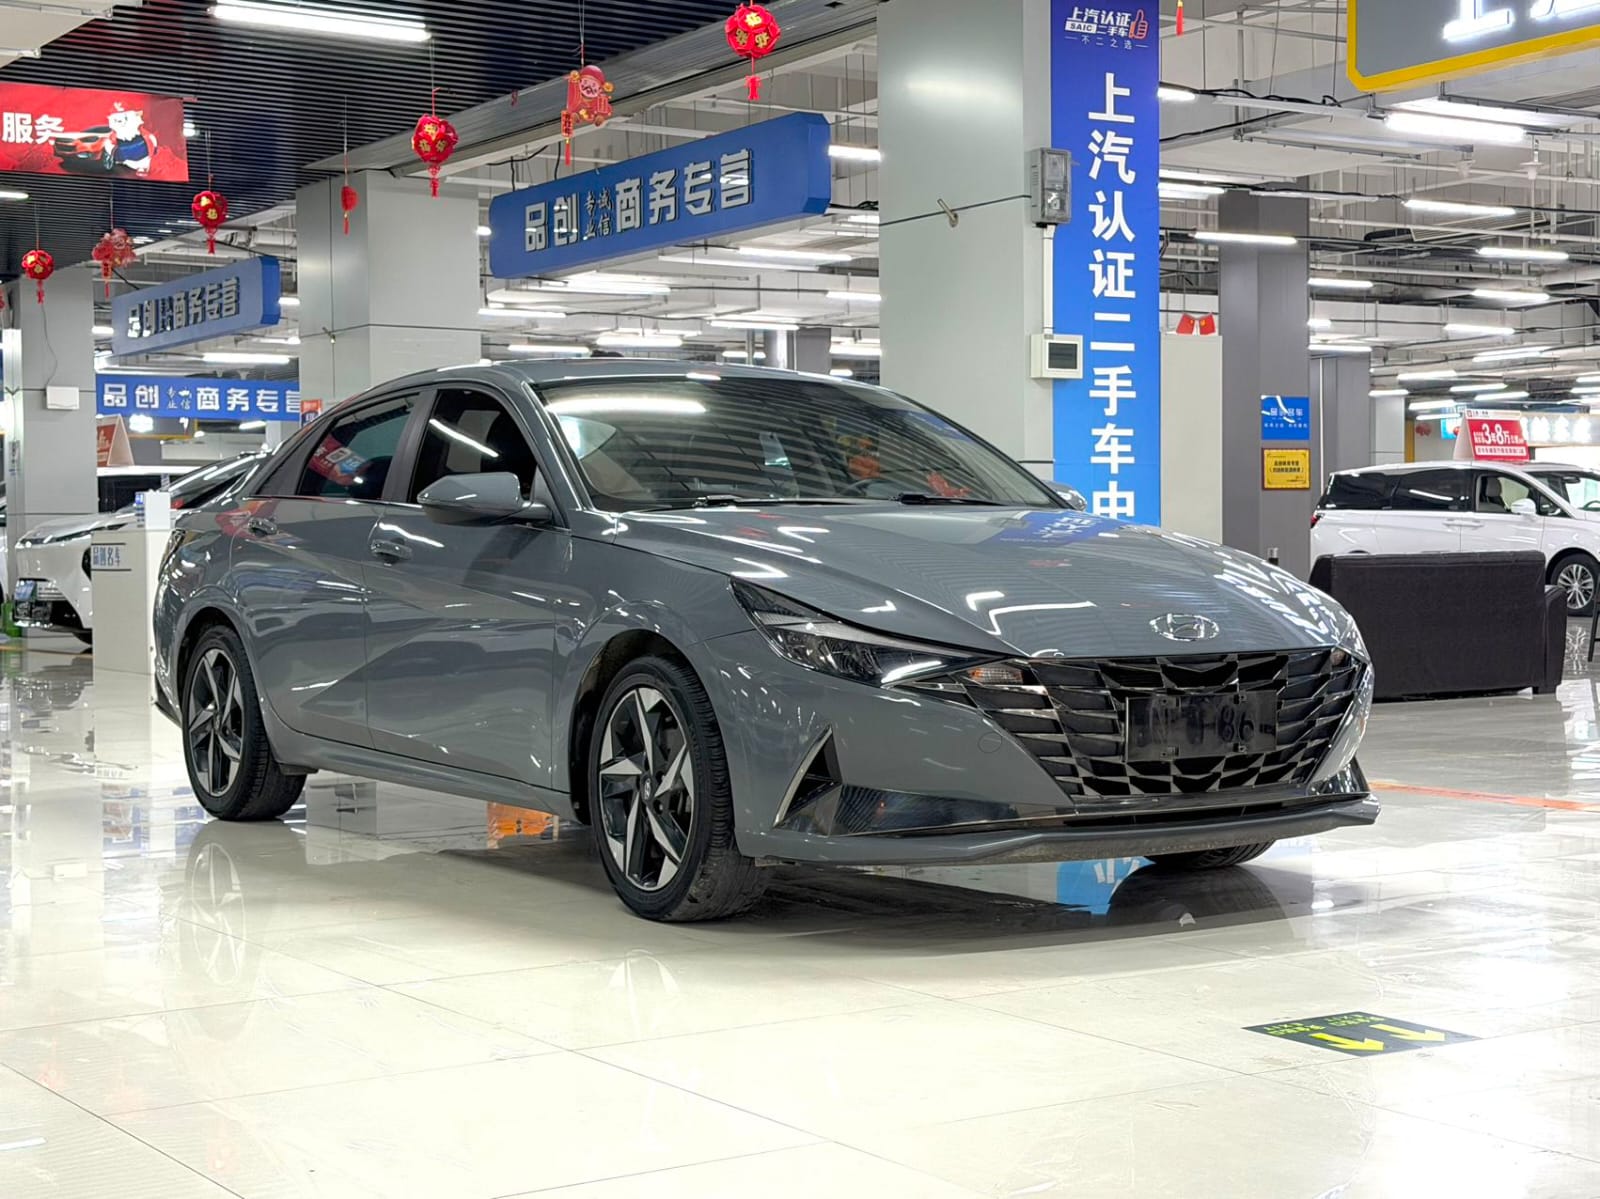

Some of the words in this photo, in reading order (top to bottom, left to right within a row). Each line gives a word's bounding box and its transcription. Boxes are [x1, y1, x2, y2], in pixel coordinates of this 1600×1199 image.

[1066, 7, 1131, 27] 上汽认证
[1069, 21, 1093, 32] SAIC
[1096, 25, 1129, 37] 二手车
[2, 111, 64, 144] 服务
